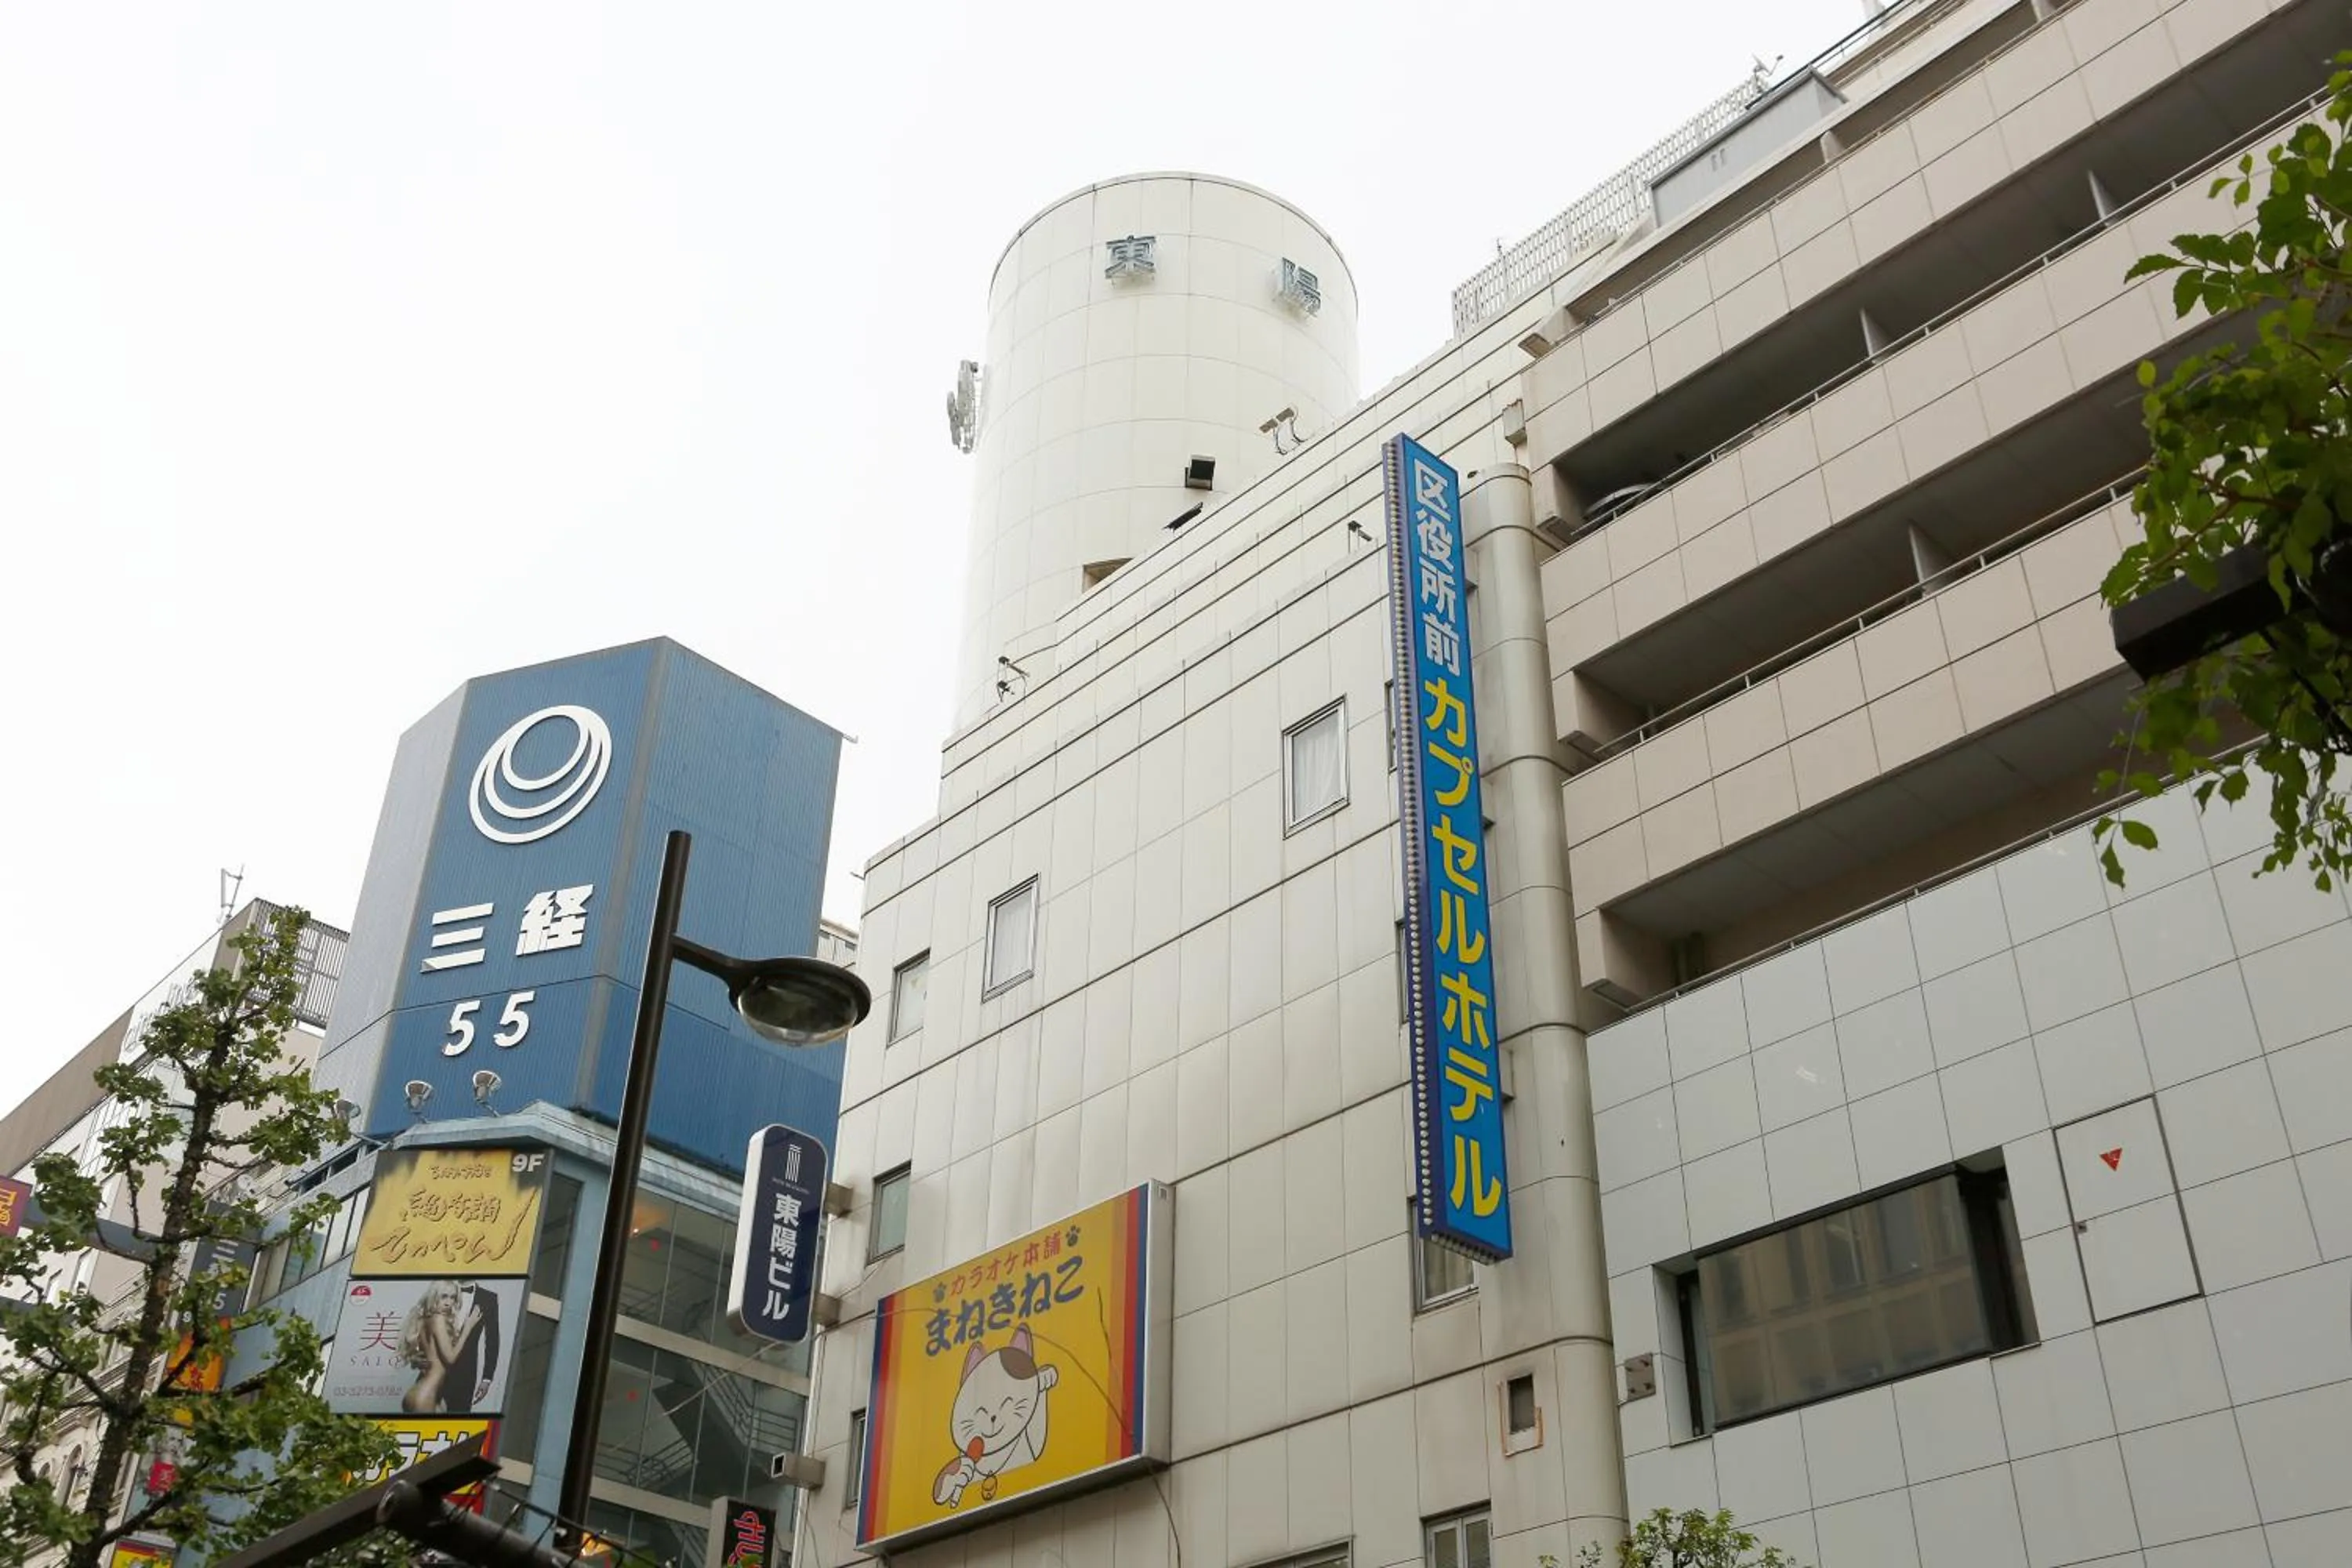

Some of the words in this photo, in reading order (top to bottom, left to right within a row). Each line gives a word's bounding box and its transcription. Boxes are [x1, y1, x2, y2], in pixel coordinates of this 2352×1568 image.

[1414, 459, 1501, 1217] 区役所前カプセルホテル
[420, 884, 593, 972] 三経
[441, 991, 535, 1056] 55
[512, 1154, 544, 1173] 9F
[762, 1192, 802, 1320] 東陽ビル
[950, 1230, 1062, 1296] カラオケ本舗
[358, 1311, 402, 1351] 美
[925, 1255, 1084, 1357] まねきねこ
